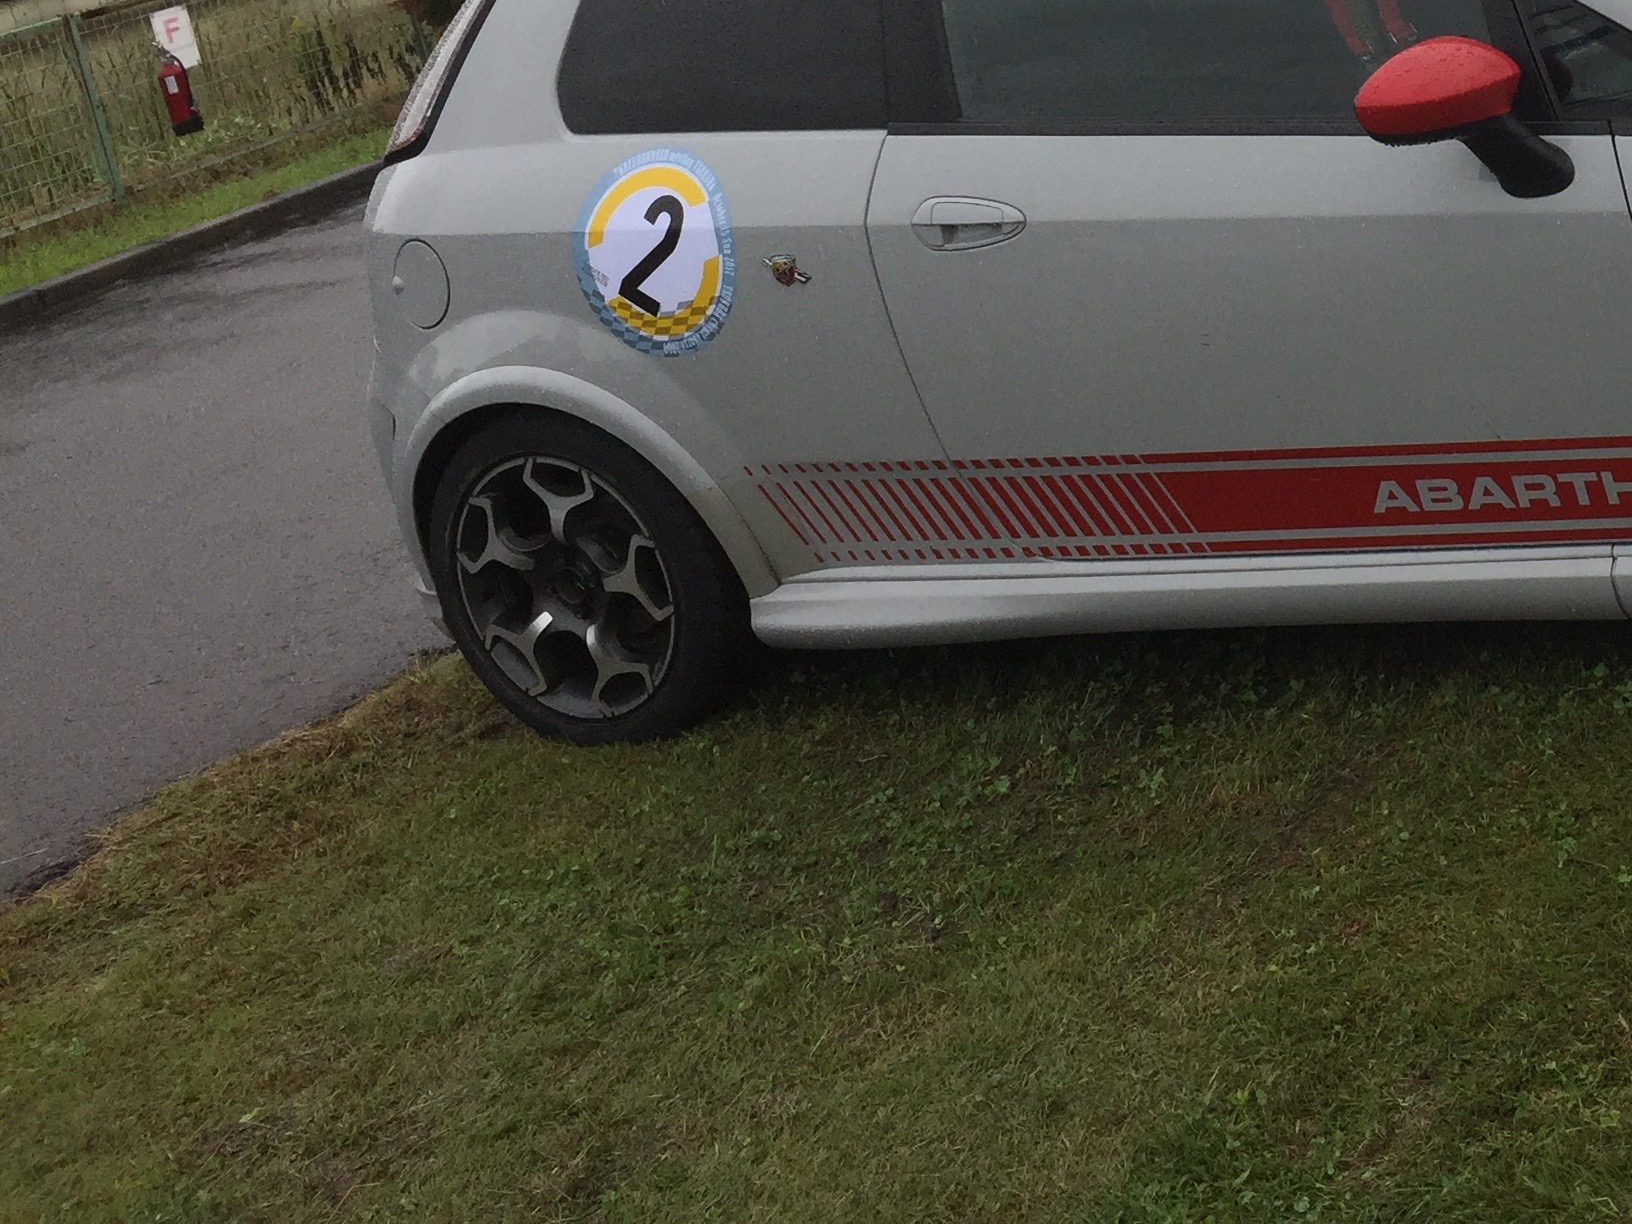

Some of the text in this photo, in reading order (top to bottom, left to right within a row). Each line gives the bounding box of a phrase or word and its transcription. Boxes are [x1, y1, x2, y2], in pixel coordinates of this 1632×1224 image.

[163, 17, 180, 44] F
[617, 194, 685, 317] 2
[723, 256, 735, 276] 2017
